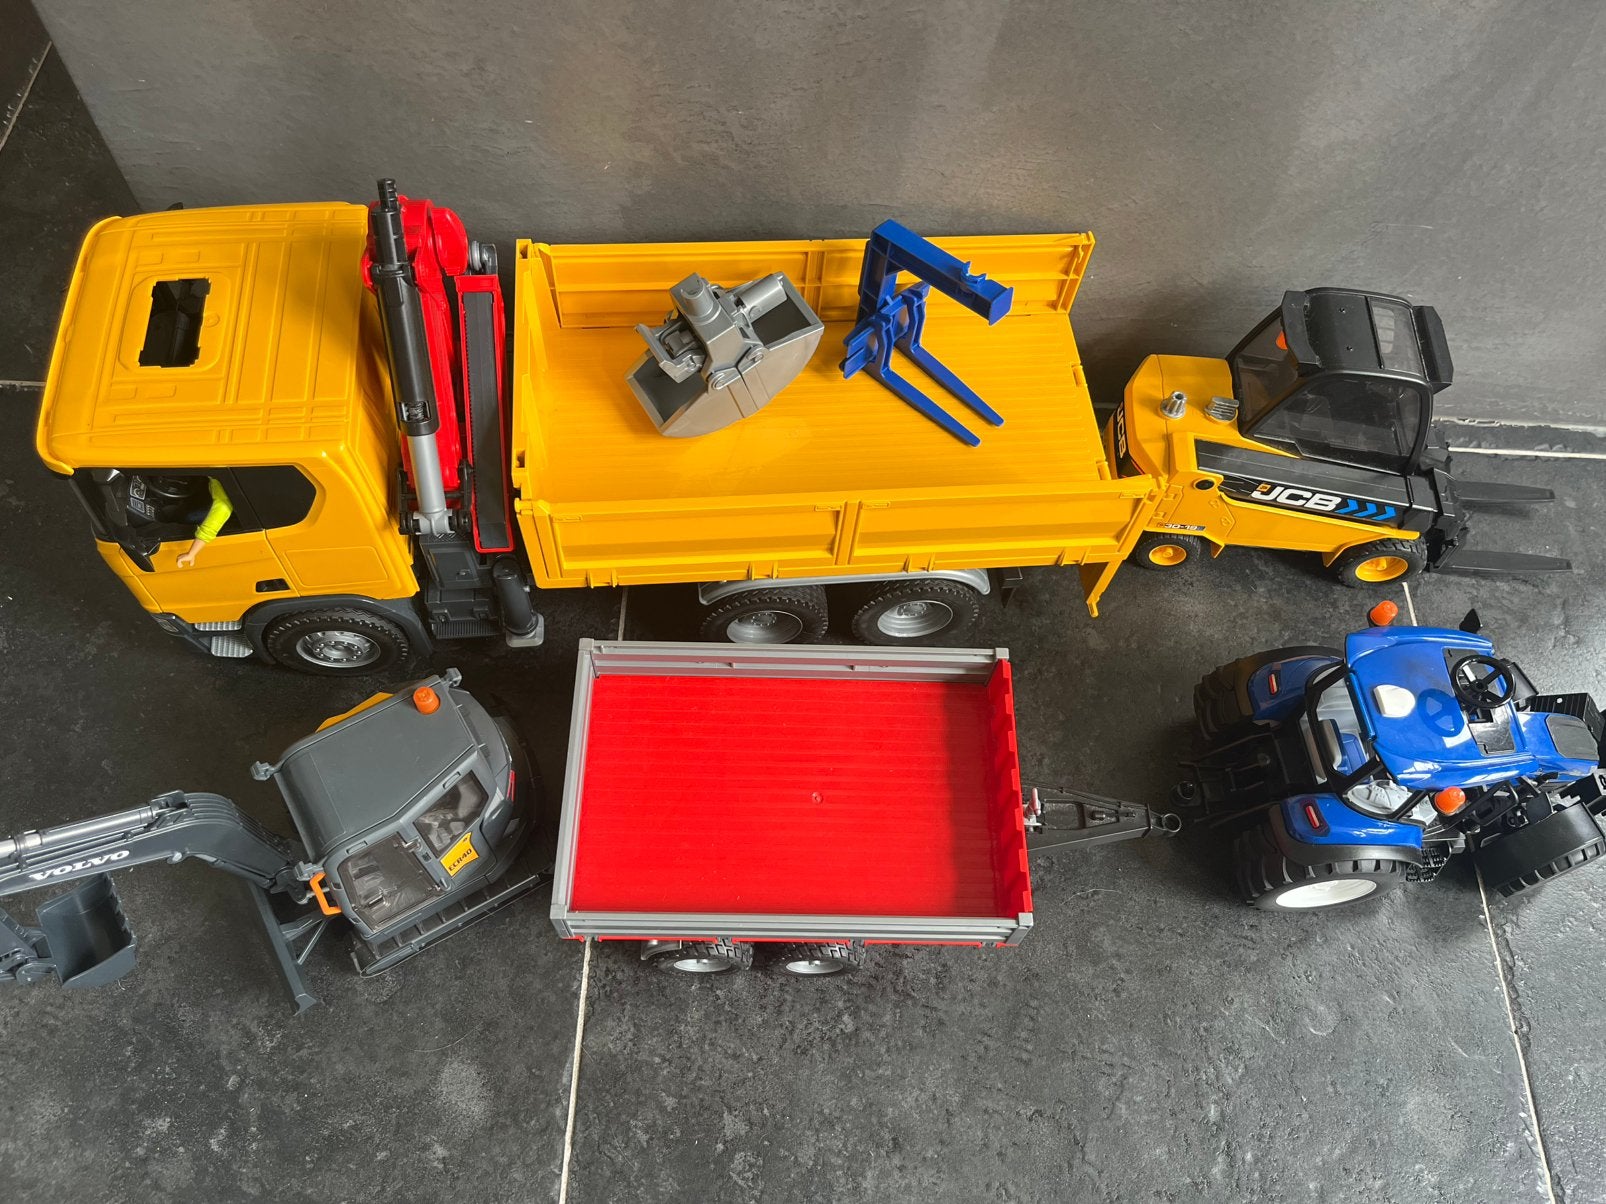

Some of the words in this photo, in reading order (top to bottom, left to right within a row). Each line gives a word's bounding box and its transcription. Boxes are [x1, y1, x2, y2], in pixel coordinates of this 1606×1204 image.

[1250, 485, 1342, 512] JCB
[28, 850, 130, 880] VOLVO
[448, 848, 472, 871] ECR40
